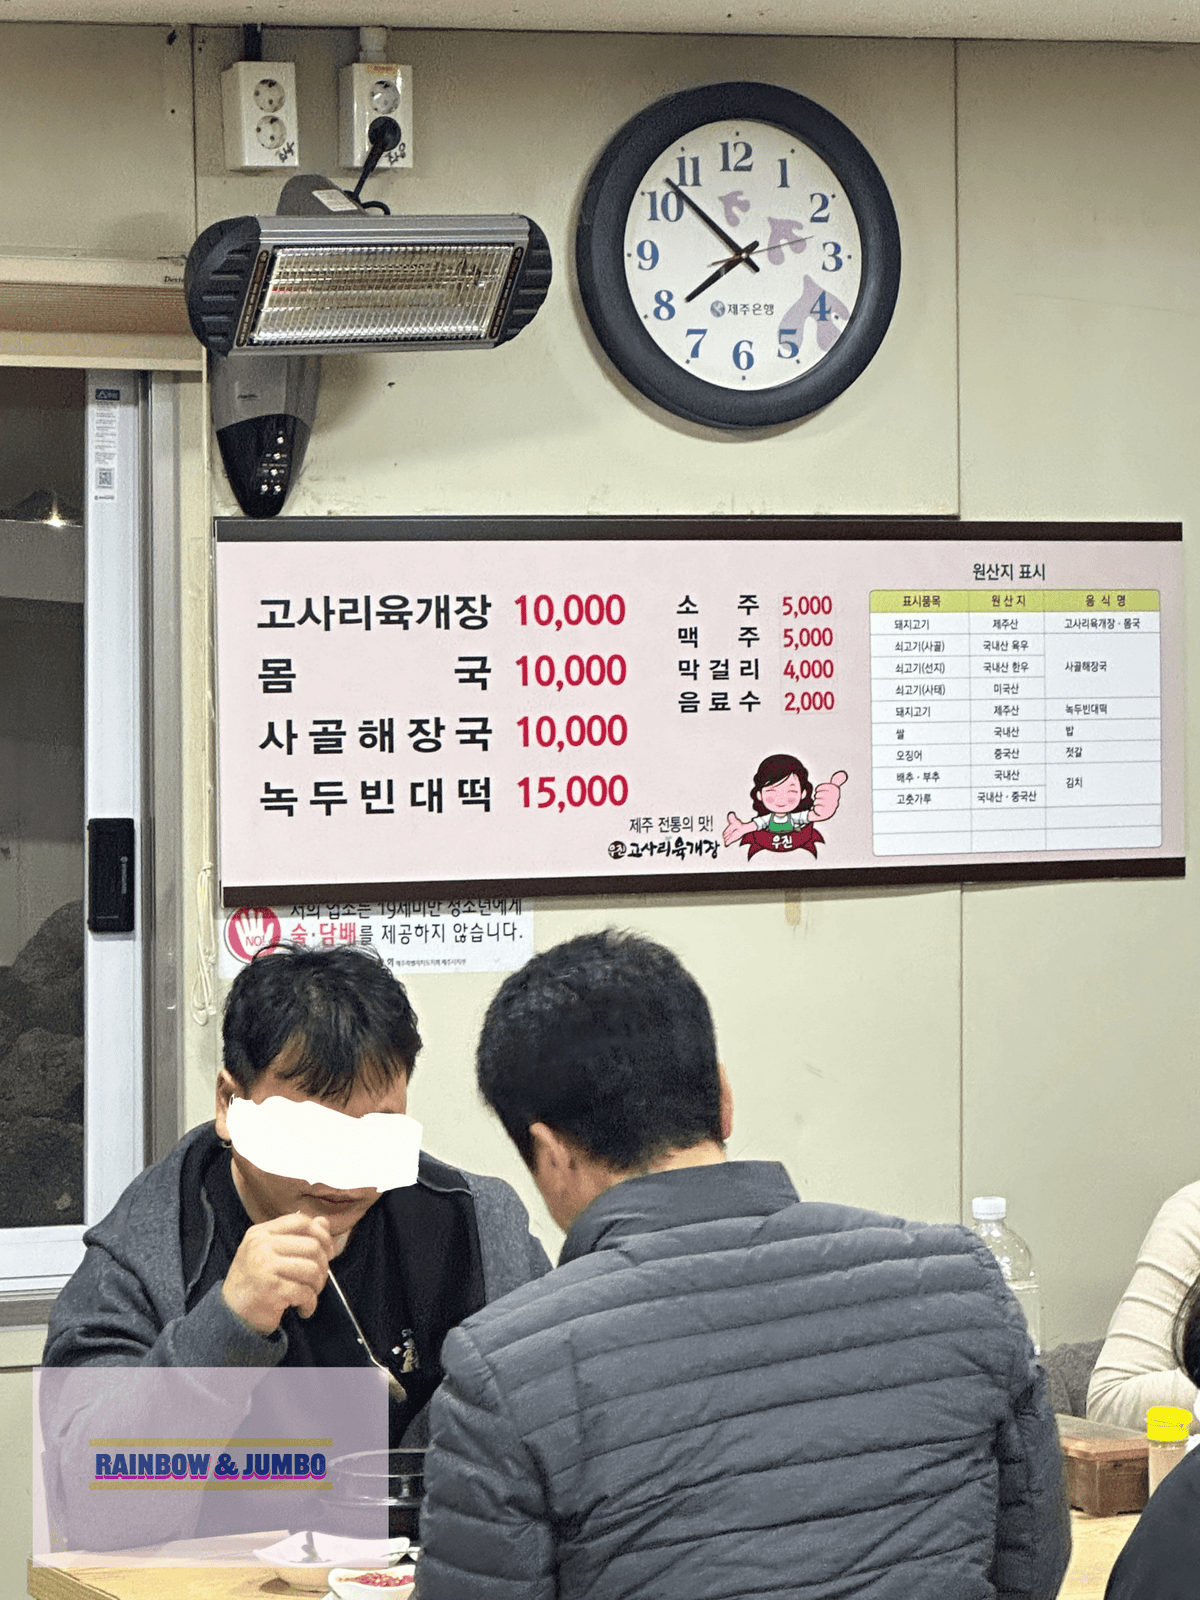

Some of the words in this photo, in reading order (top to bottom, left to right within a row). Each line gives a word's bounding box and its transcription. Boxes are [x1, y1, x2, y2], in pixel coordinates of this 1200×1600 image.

[720, 142, 753, 171] 12
[676, 155, 702, 187] 11
[778, 158, 789, 188] 1
[645, 190, 686, 223] 10
[809, 193, 830, 223] 2
[637, 240, 659, 270] 9
[822, 242, 842, 272] 3
[653, 290, 675, 320] 8
[728, 303, 774, 315] 제주은행
[809, 291, 832, 321] 4
[686, 329, 707, 360] 7
[777, 329, 799, 359] 5
[733, 340, 754, 370] 6
[973, 564, 1013, 581] 원산지
[1019, 564, 1045, 581] 표시
[783, 596, 832, 618] 5,000
[903, 596, 940, 607] 표시품목
[257, 594, 492, 631] 고사리육개장
[515, 594, 625, 631] 10,000
[895, 620, 929, 630] 돼지고기
[993, 619, 1018, 630] 제주산
[784, 627, 833, 650] 5,000
[983, 641, 1008, 651] 국내산
[1012, 640, 1028, 650] 육우
[895, 641, 944, 652] 쇠고기(사골)
[516, 654, 626, 692] 10,000
[783, 659, 834, 682] 4,000
[896, 663, 945, 674] 쇠고기(선지)
[984, 662, 1008, 673] 국내산
[1013, 662, 1028, 673] 한우
[1065, 661, 1107, 672] 사골해장국
[896, 684, 945, 695] 쇠고기(사태)
[994, 684, 1019, 694] 미국산
[785, 691, 835, 714] 2,000
[1066, 704, 1107, 715] 녹두빈대떡
[896, 707, 930, 717] 돼지고기
[994, 705, 1019, 716] 제주산
[517, 714, 627, 752] 10,000
[896, 729, 904, 739] 쌀
[994, 727, 1019, 737] 국내산
[1066, 726, 1074, 736] 밥
[897, 751, 922, 761] 오징어
[994, 749, 1019, 759] 중국산
[1066, 747, 1082, 758] 젓갈
[995, 770, 1020, 780] 국내산
[1066, 777, 1082, 788] 김치
[517, 775, 628, 813] 15,000
[897, 794, 931, 805] 고춧가루
[630, 818, 653, 833] 제주
[657, 816, 694, 833] 전통의
[699, 816, 713, 831] 맛!
[627, 837, 720, 860] 고사리육개장
[772, 835, 793, 849] 우진
[382, 924, 444, 944] 제공하지
[453, 922, 522, 943] 않습니다.
[246, 935, 265, 947] NO!
